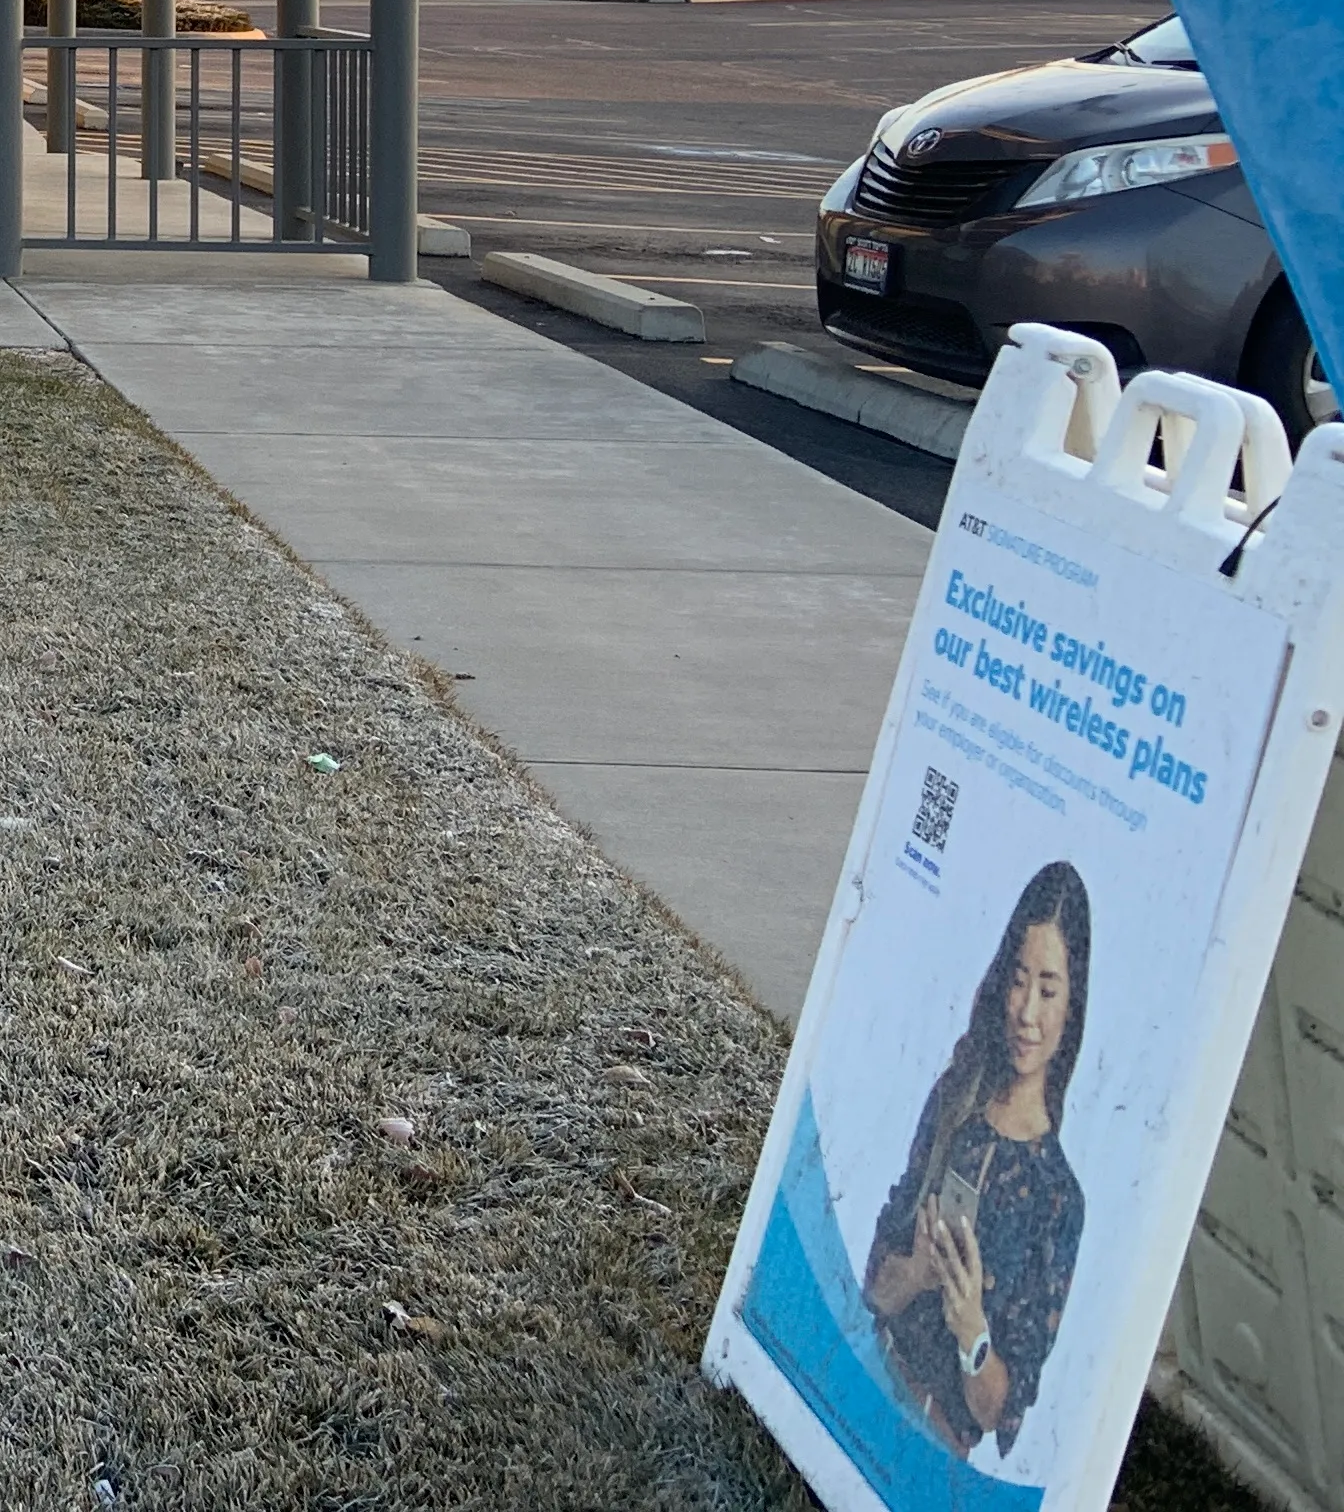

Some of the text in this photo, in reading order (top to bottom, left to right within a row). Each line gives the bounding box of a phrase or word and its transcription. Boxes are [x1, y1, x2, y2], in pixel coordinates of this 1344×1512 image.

[958, 511, 988, 538] AT&T
[934, 627, 1208, 805] our best wireless plans
[945, 568, 1187, 727] Exclusive savings on
